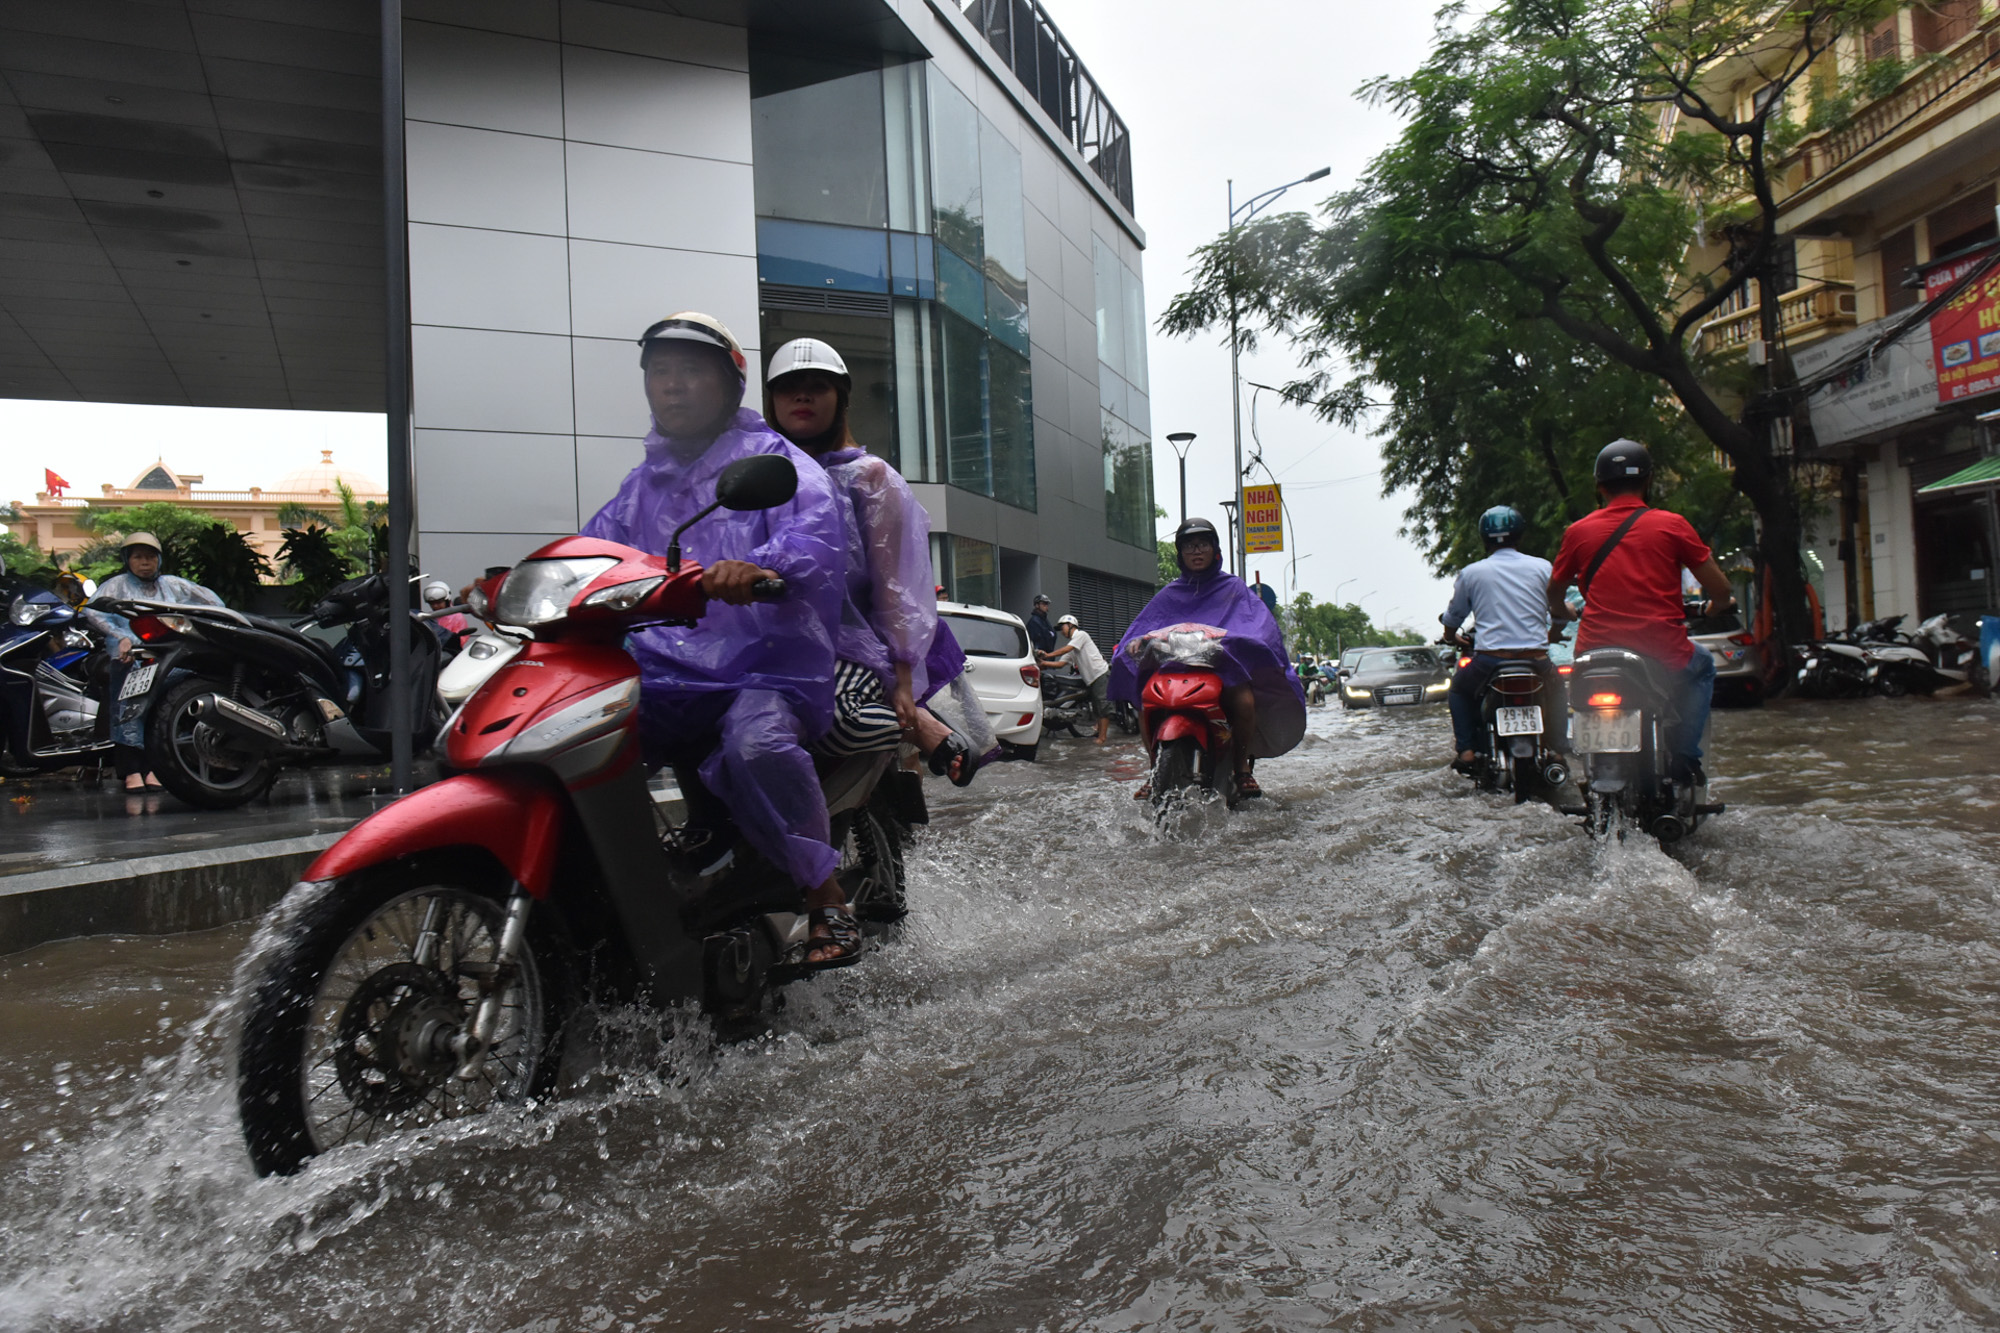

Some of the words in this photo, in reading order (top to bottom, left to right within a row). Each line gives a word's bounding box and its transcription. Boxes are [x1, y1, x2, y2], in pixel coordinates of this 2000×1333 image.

[1247, 486, 1276, 505] NHÀ
[1246, 503, 1279, 524] NGHỈ
[1504, 720, 1538, 733] 2259
[1582, 731, 1631, 751] 9460
